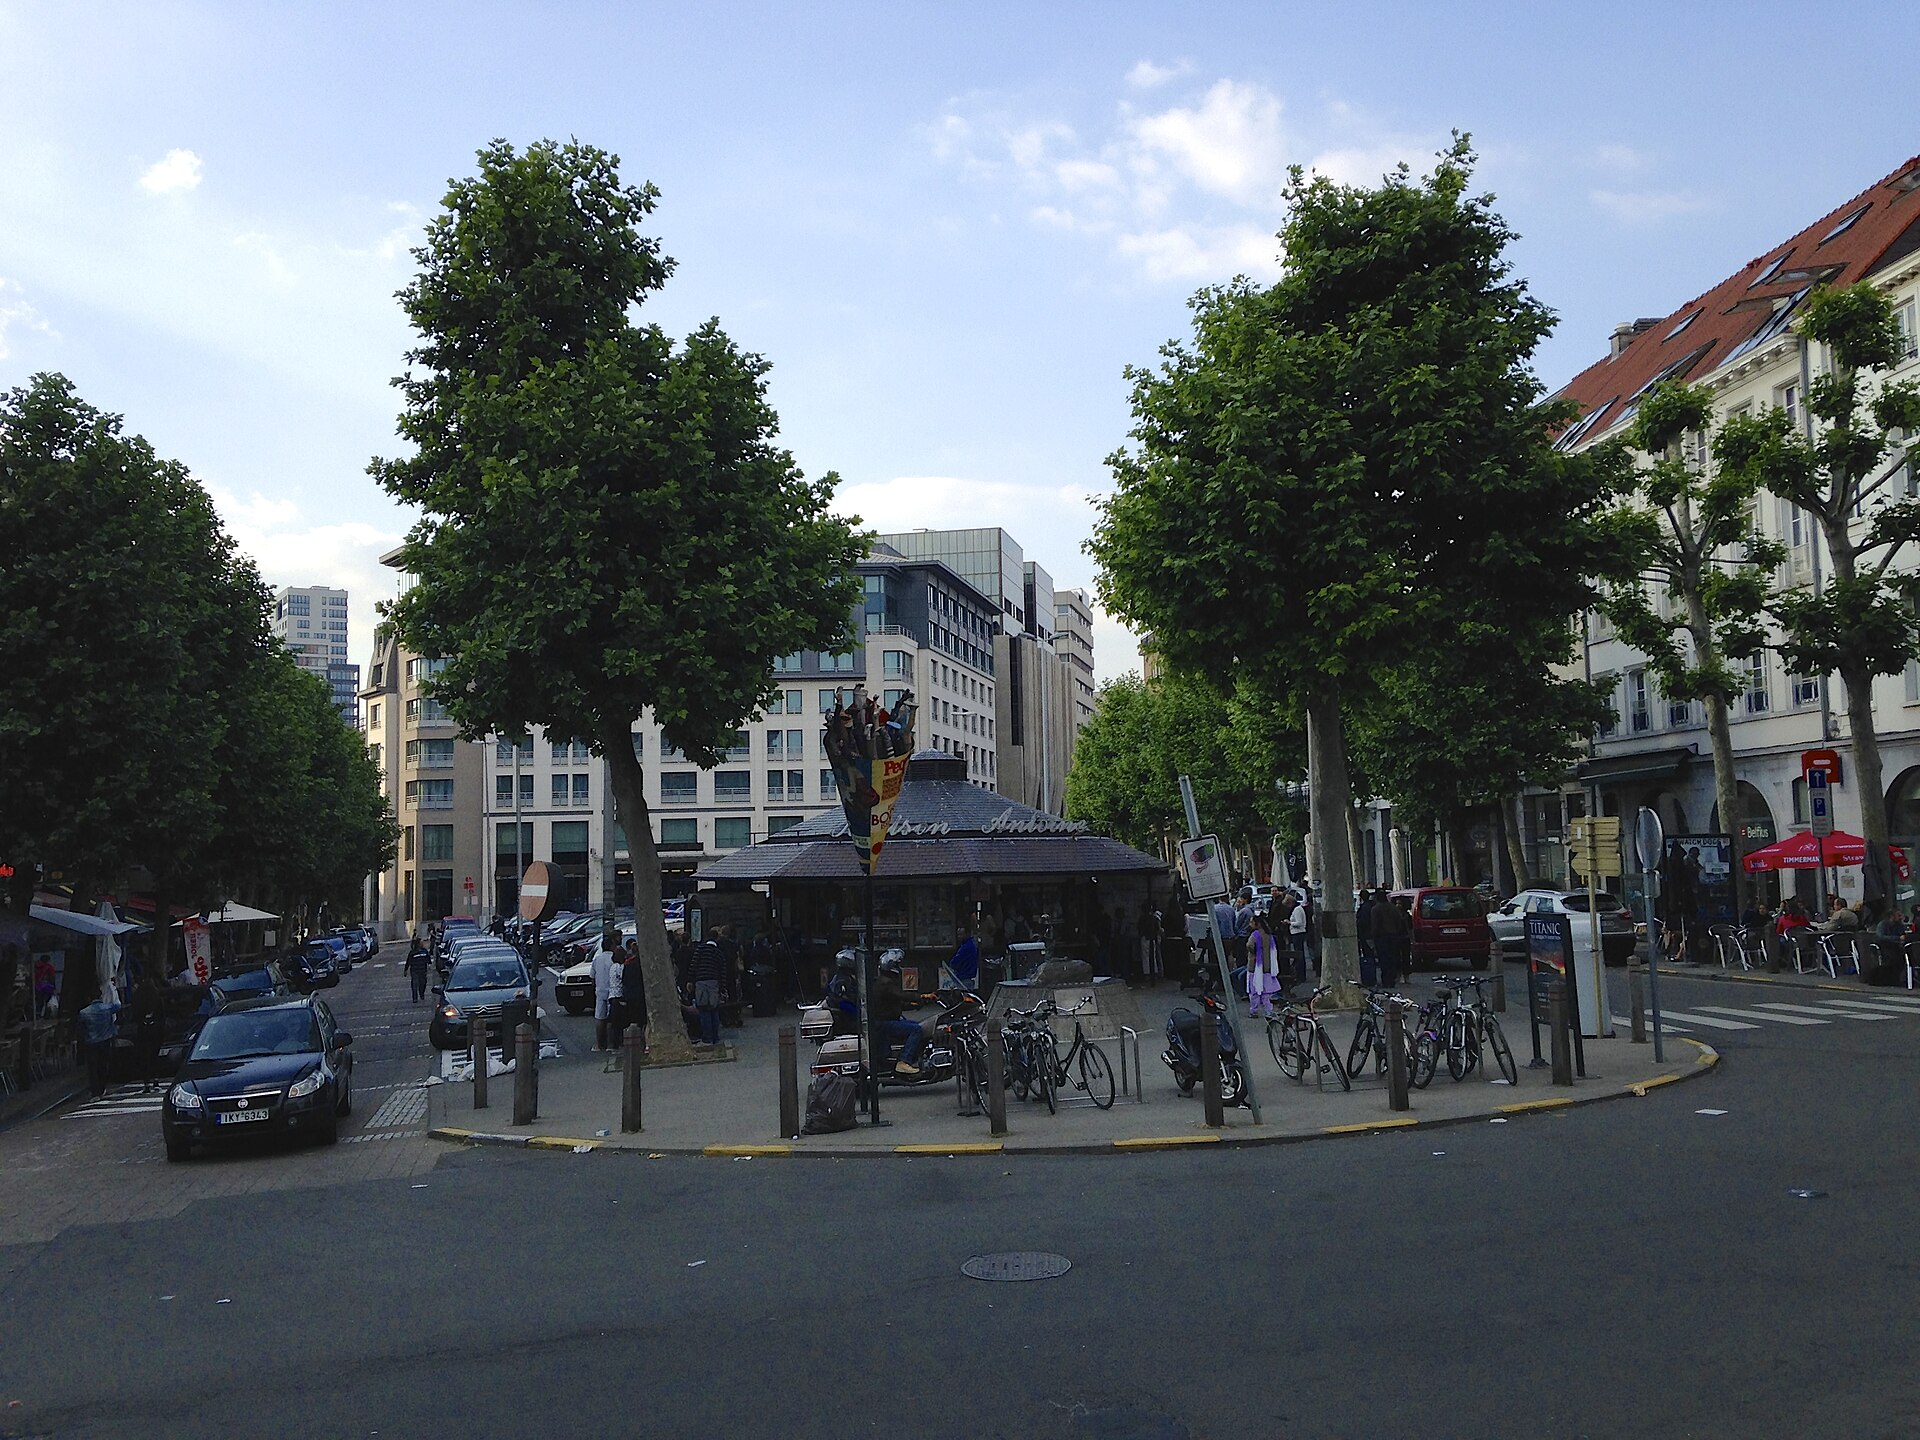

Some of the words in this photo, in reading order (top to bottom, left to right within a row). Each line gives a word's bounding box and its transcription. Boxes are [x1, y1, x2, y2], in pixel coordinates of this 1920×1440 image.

[981, 806, 1091, 834] Antoine
[1747, 825, 1769, 839] Belfius
[1529, 922, 1560, 935] TITANIC
